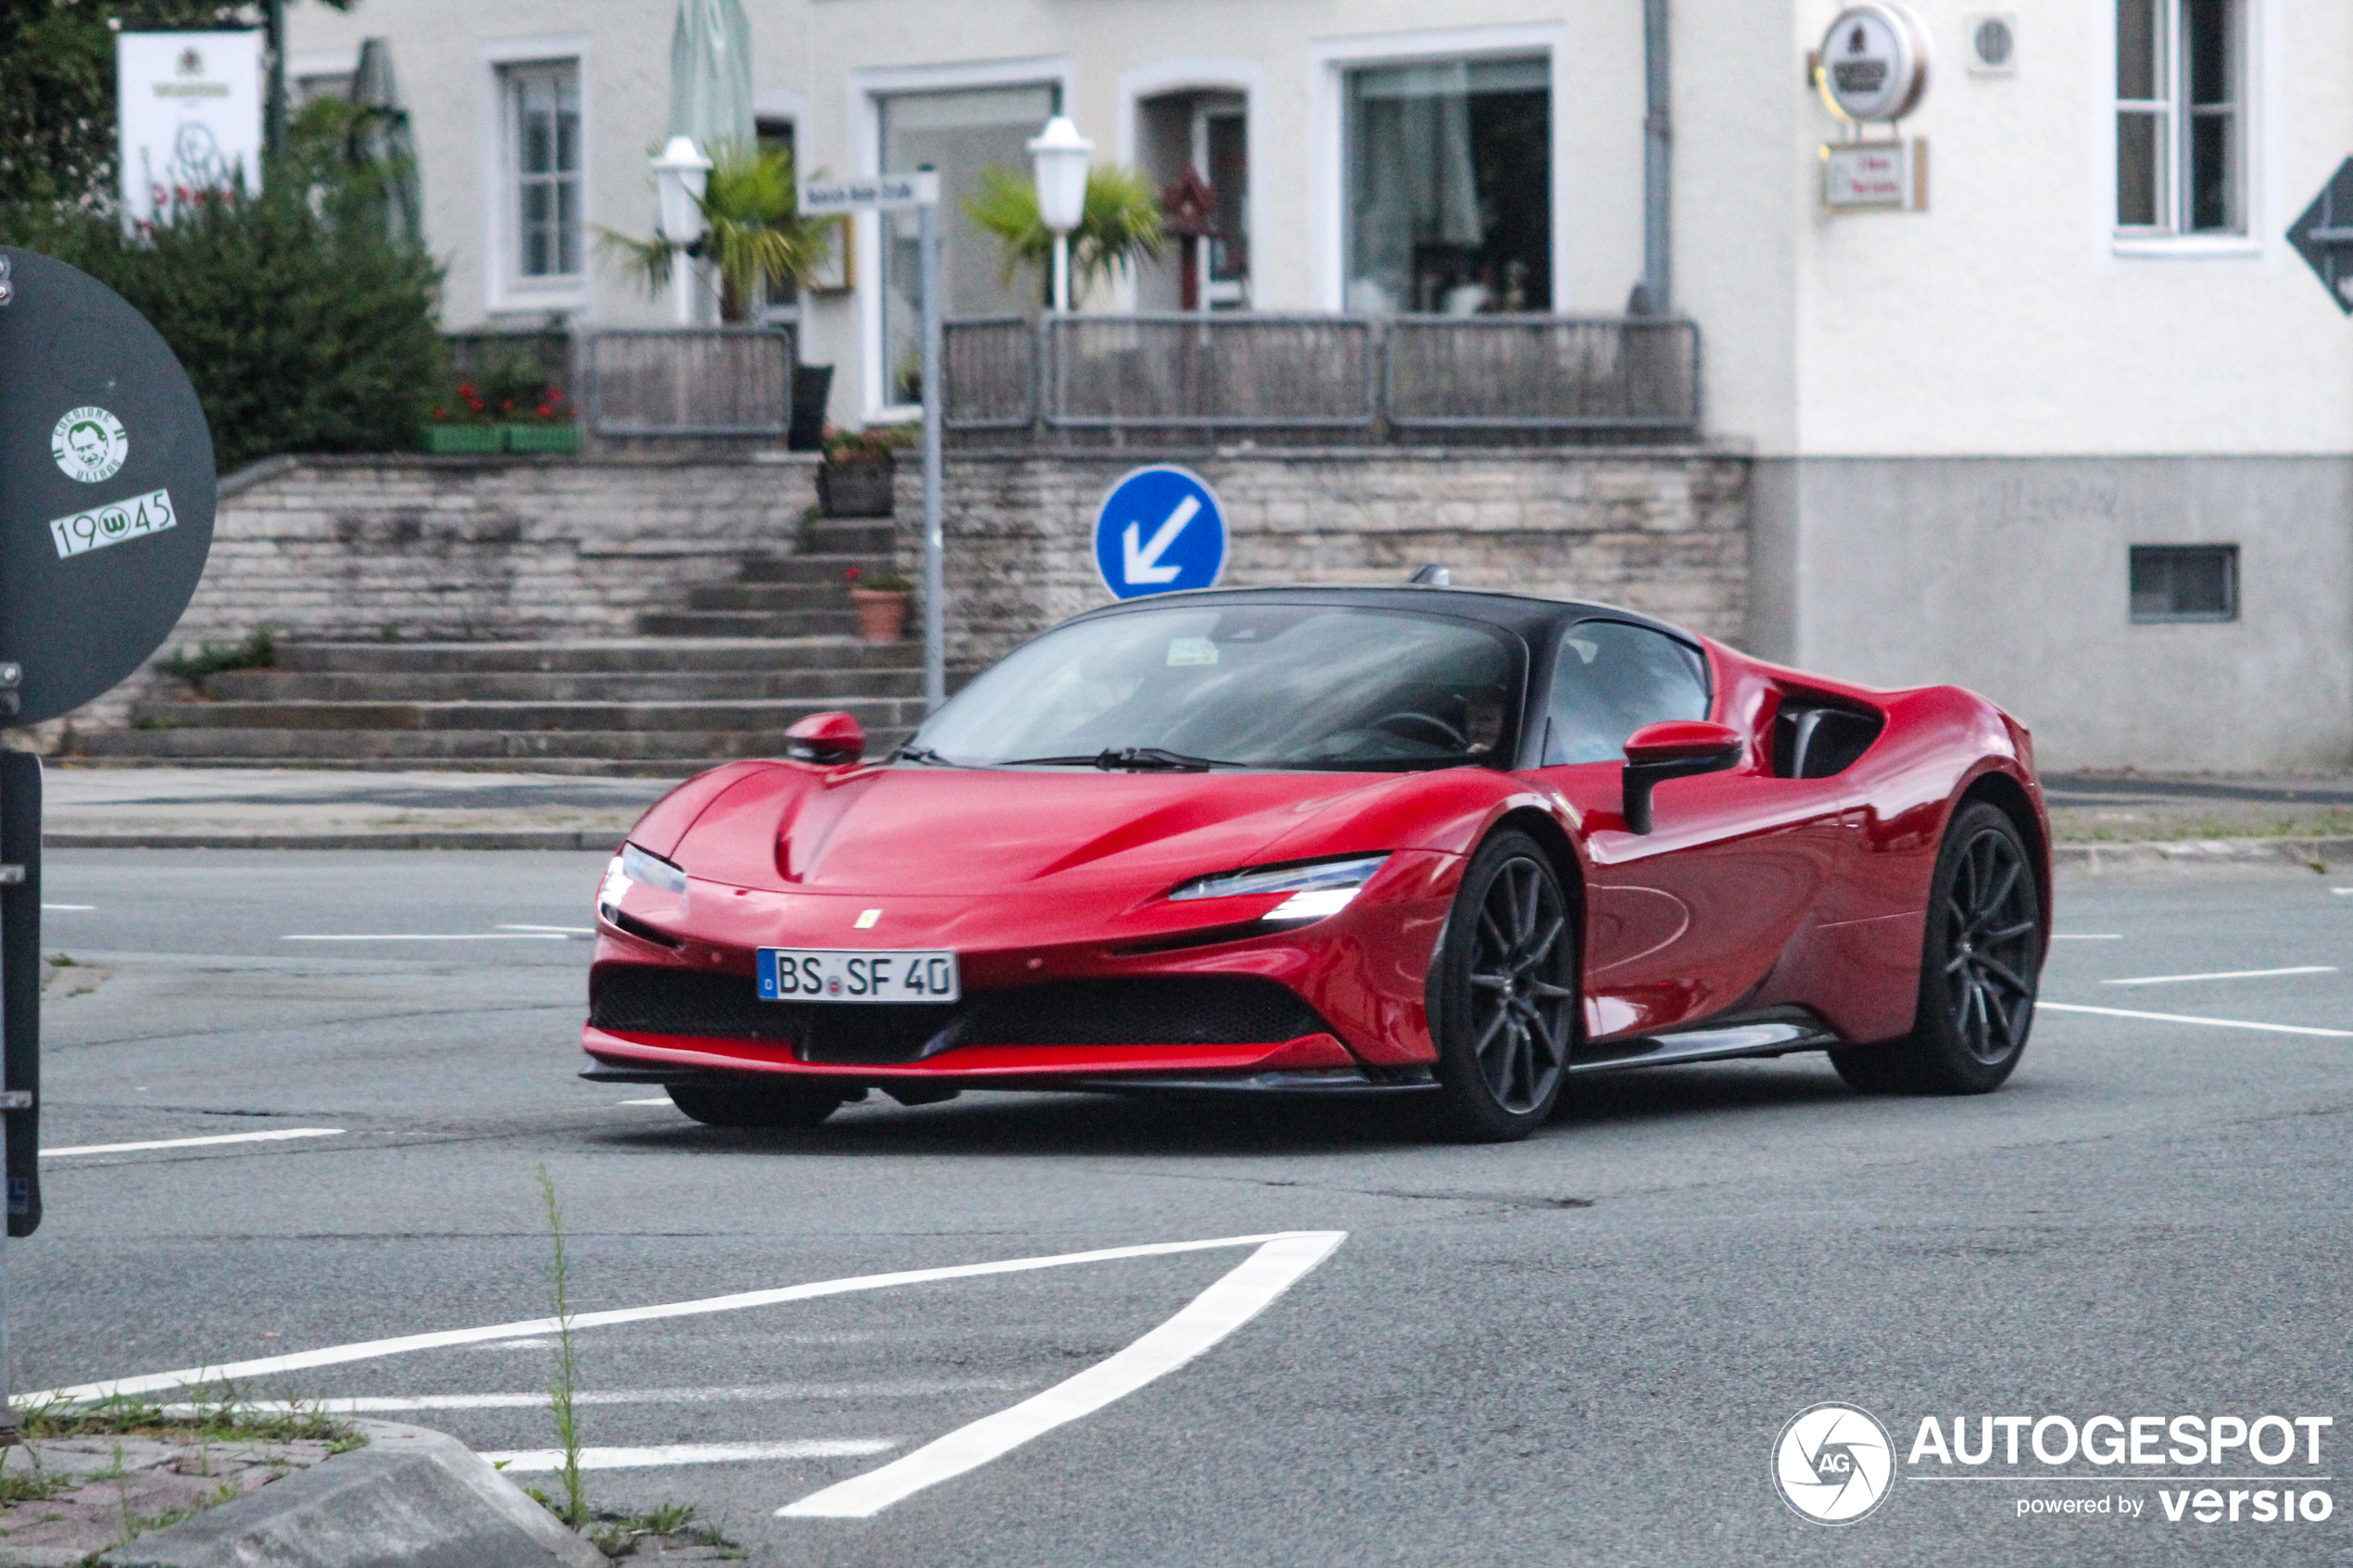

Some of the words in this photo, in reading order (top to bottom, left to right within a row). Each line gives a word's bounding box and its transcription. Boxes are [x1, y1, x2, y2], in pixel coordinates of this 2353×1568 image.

[54, 408, 113, 437] COESIONE
[76, 459, 123, 481] ULTRAS
[764, 978, 774, 990] D
[778, 956, 823, 996] BS
[847, 958, 892, 996] SF
[904, 958, 950, 996] 40
